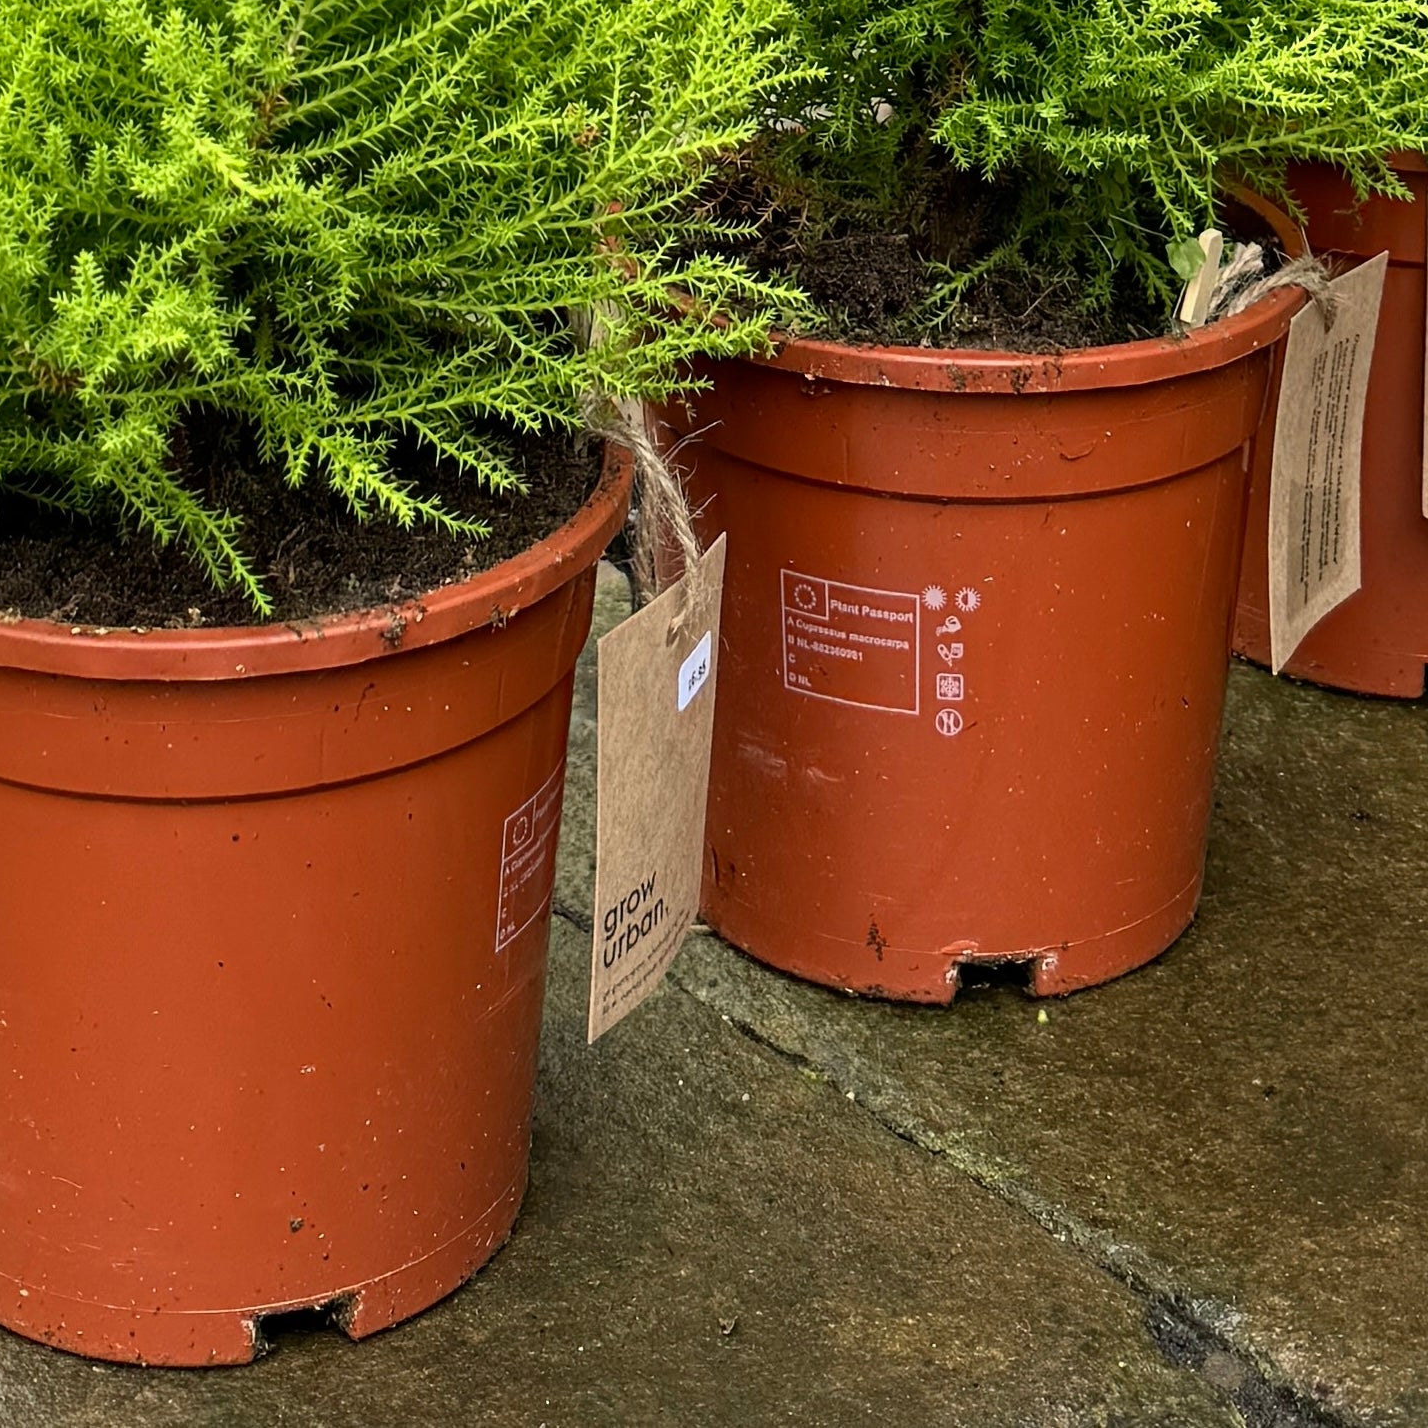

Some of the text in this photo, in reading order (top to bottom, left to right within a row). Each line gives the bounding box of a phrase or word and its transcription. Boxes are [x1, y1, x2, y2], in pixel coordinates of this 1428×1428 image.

[830, 599, 914, 623] Plant Passport
[786, 616, 910, 650] A Cupressus macrocarpa
[788, 653, 796, 663] C
[789, 672, 812, 686] D NL
[604, 871, 657, 941] grow
[603, 897, 669, 969] urban.
